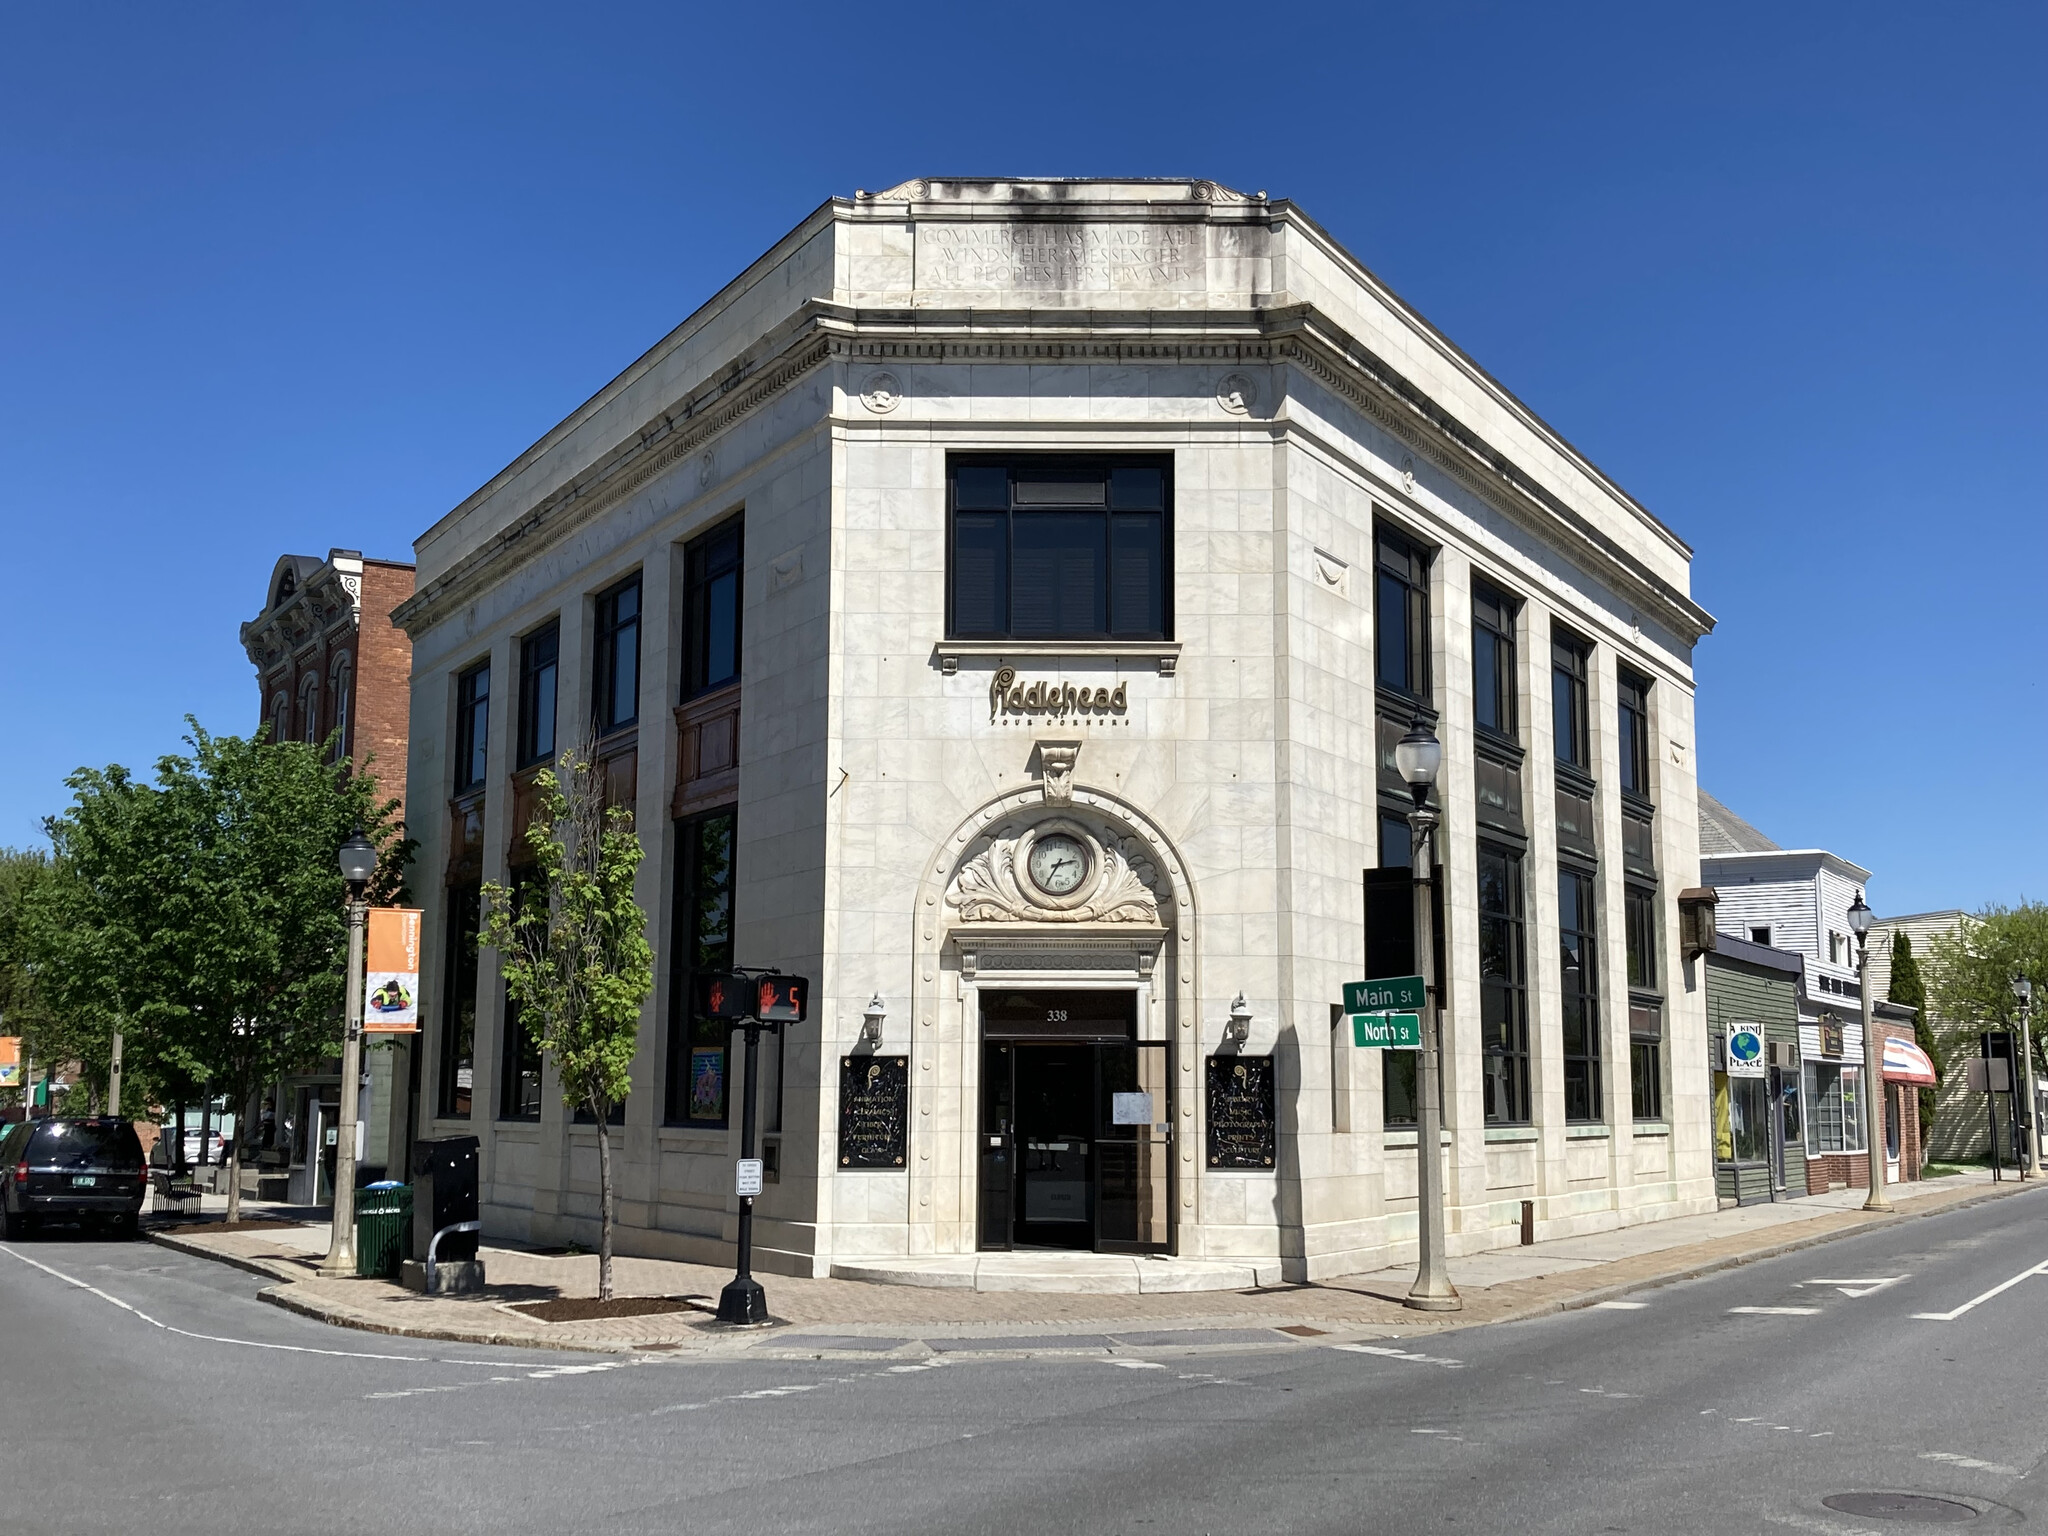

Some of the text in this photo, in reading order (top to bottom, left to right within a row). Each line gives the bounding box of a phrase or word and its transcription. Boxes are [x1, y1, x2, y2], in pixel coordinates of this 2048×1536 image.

[923, 229, 1199, 245] COMMERCE HAS MADE ALL
[942, 247, 1180, 264] WINDS HER MESSENGER
[930, 266, 1191, 282] ALL PEOPLES HER SERVANTS
[1039, 851, 1046, 859] 10
[405, 912, 418, 970] Bennington
[789, 987, 799, 1014] 5
[1356, 987, 1412, 1007] Main St
[1047, 1010, 1068, 1021] 338
[1364, 1022, 1409, 1040] North St
[1740, 1025, 1761, 1035] KIND
[1729, 1057, 1762, 1067] PLACE
